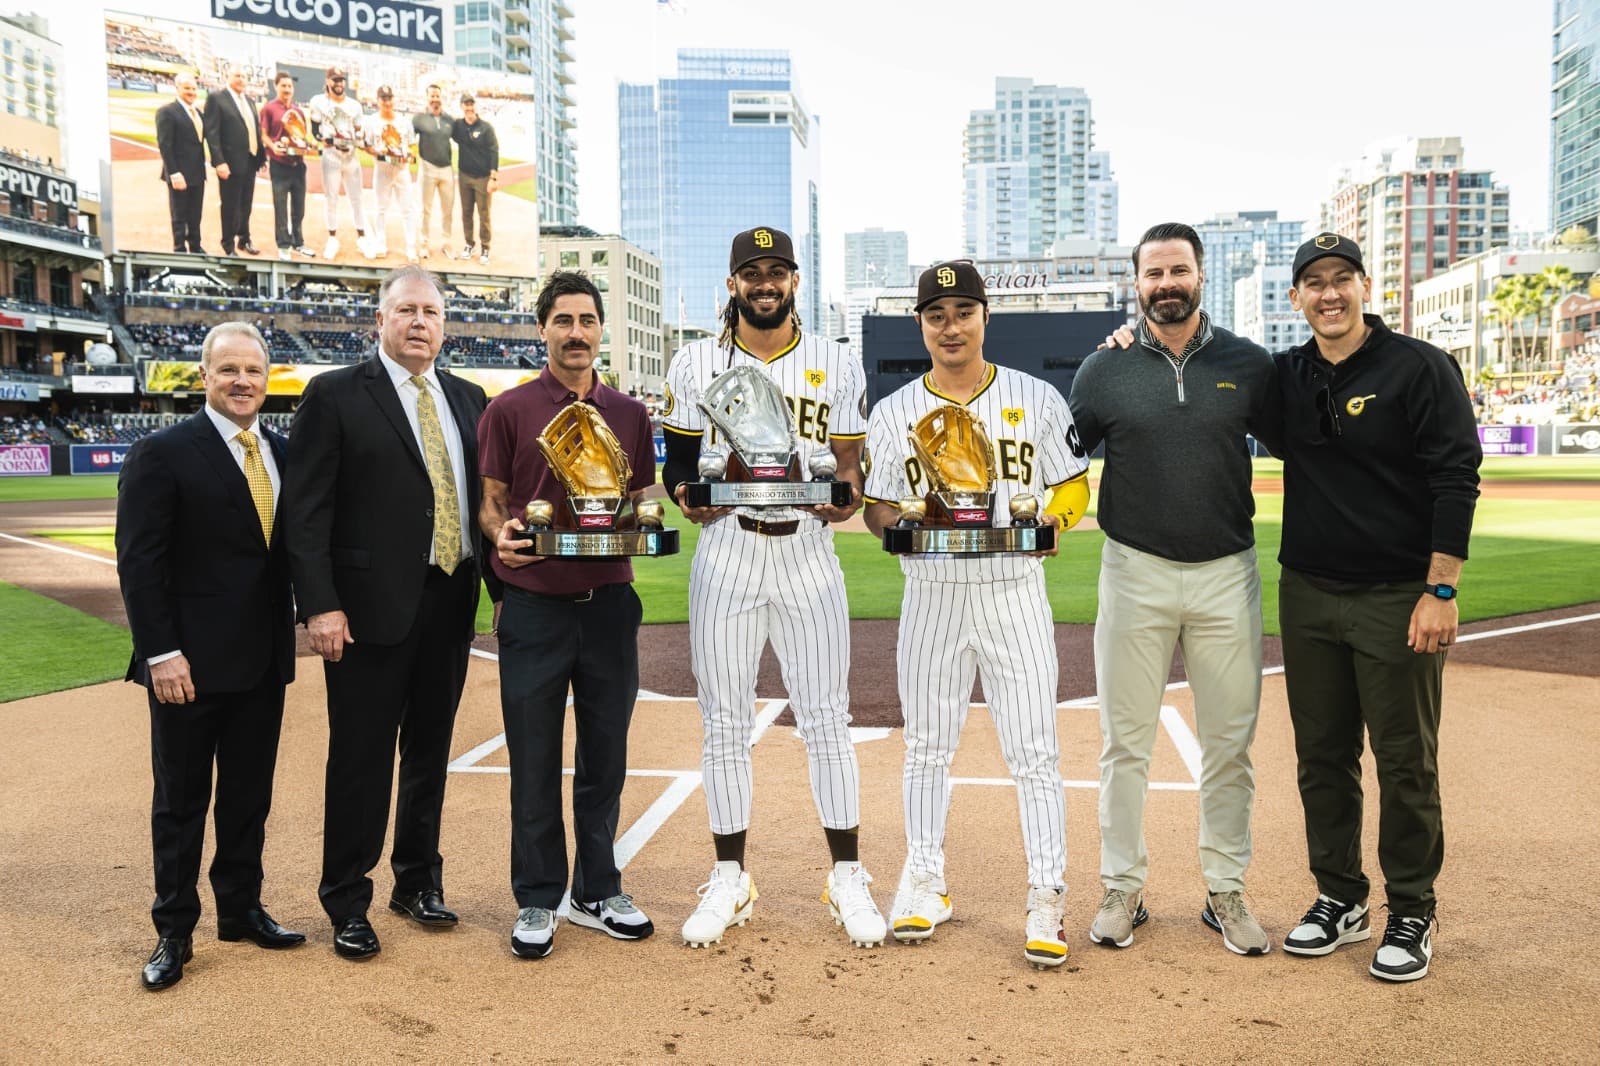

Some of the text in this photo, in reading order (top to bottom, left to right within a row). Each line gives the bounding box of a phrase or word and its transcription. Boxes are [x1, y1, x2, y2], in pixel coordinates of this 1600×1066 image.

[349, 2, 441, 44] park
[47, 180, 77, 207] CO.
[754, 229, 773, 248] SD
[937, 266, 956, 288] SD
[810, 373, 821, 384] PS
[1007, 412, 1019, 422] PS
[92, 453, 110, 464] us
[737, 491, 776, 499] FERNANDO
